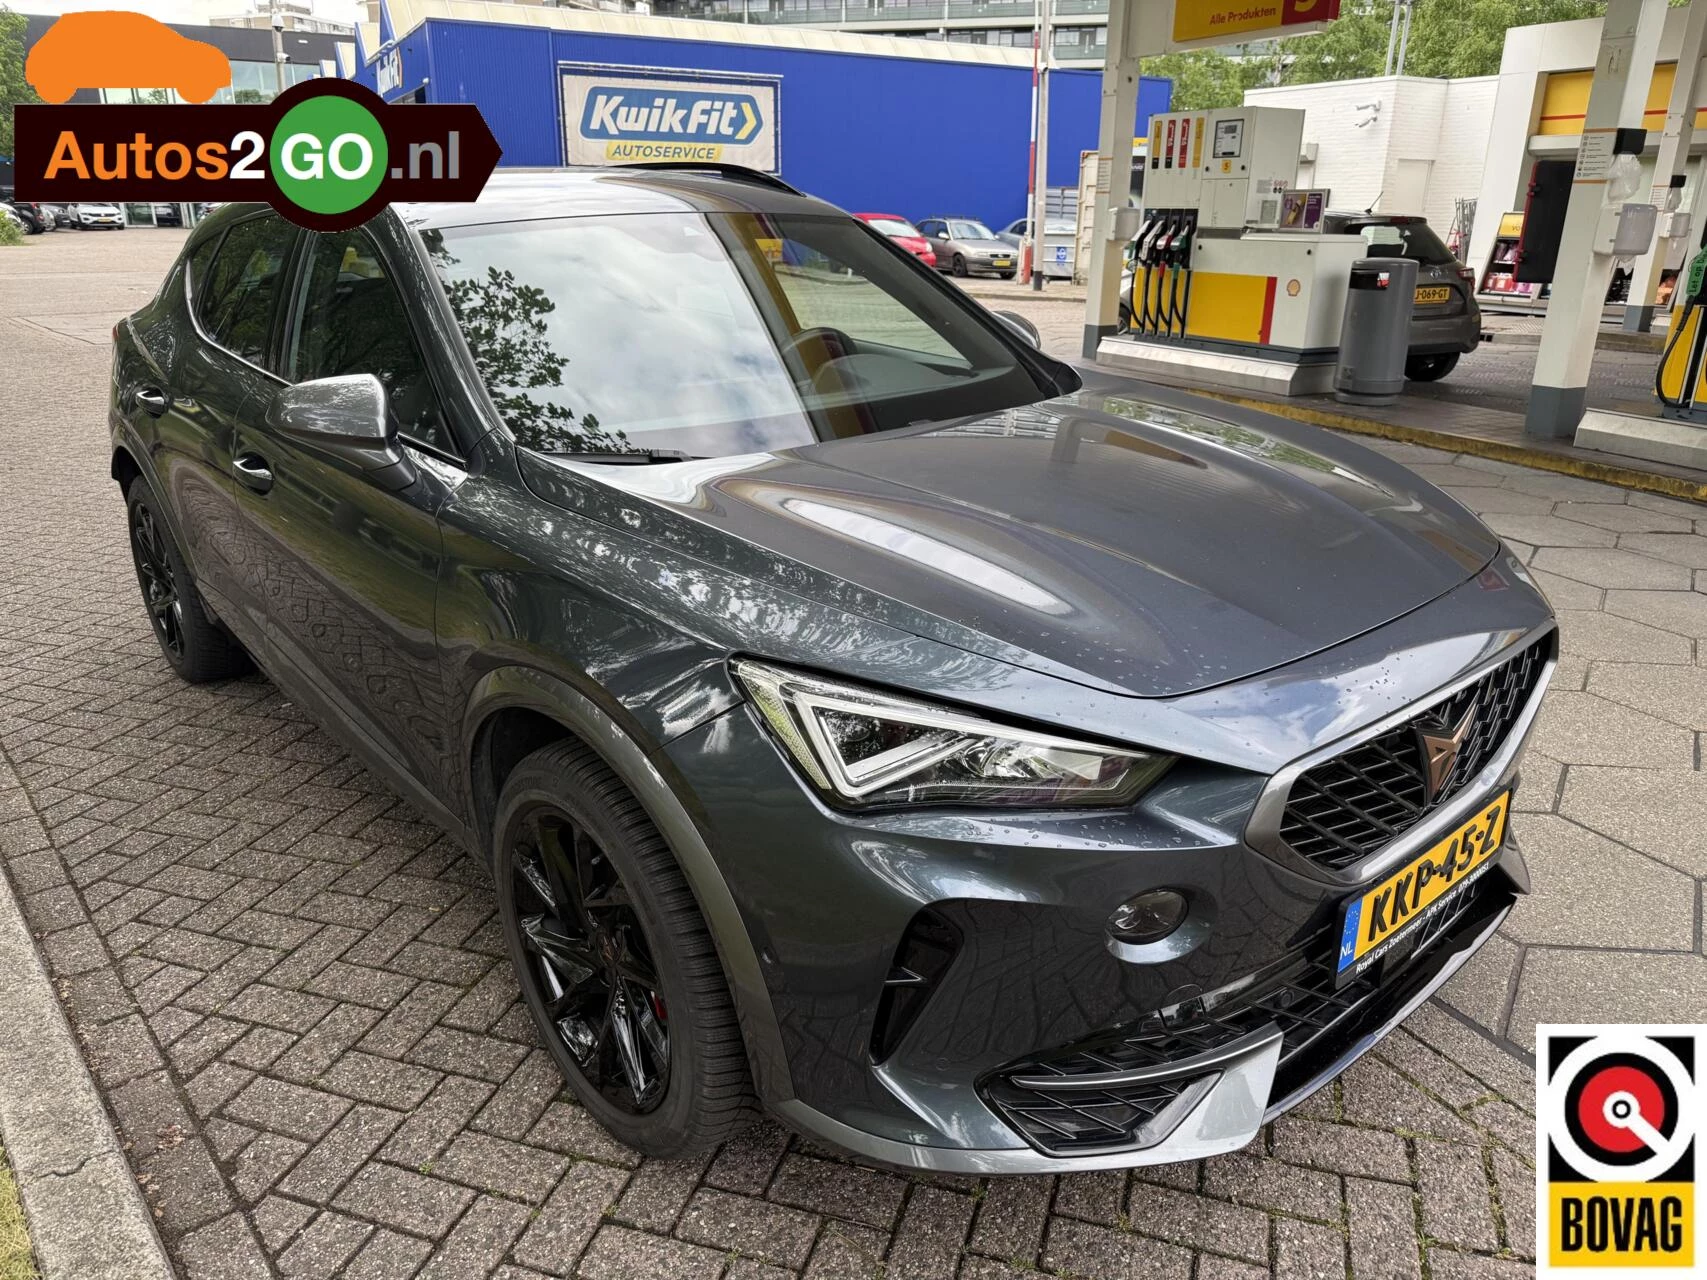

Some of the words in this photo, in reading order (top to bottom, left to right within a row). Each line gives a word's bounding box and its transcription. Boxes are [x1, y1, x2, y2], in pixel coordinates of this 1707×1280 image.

[1210, 13, 1226, 25] Alle
[1227, 7, 1276, 22] Produkten
[589, 94, 738, 136] KwikFit
[612, 144, 715, 160] AUTOSERVICE
[1416, 287, 1448, 299] J-069-GT
[1367, 805, 1501, 943] KKP-45-Z
[1340, 941, 1354, 961] NL
[1355, 952, 1375, 974] Royal
